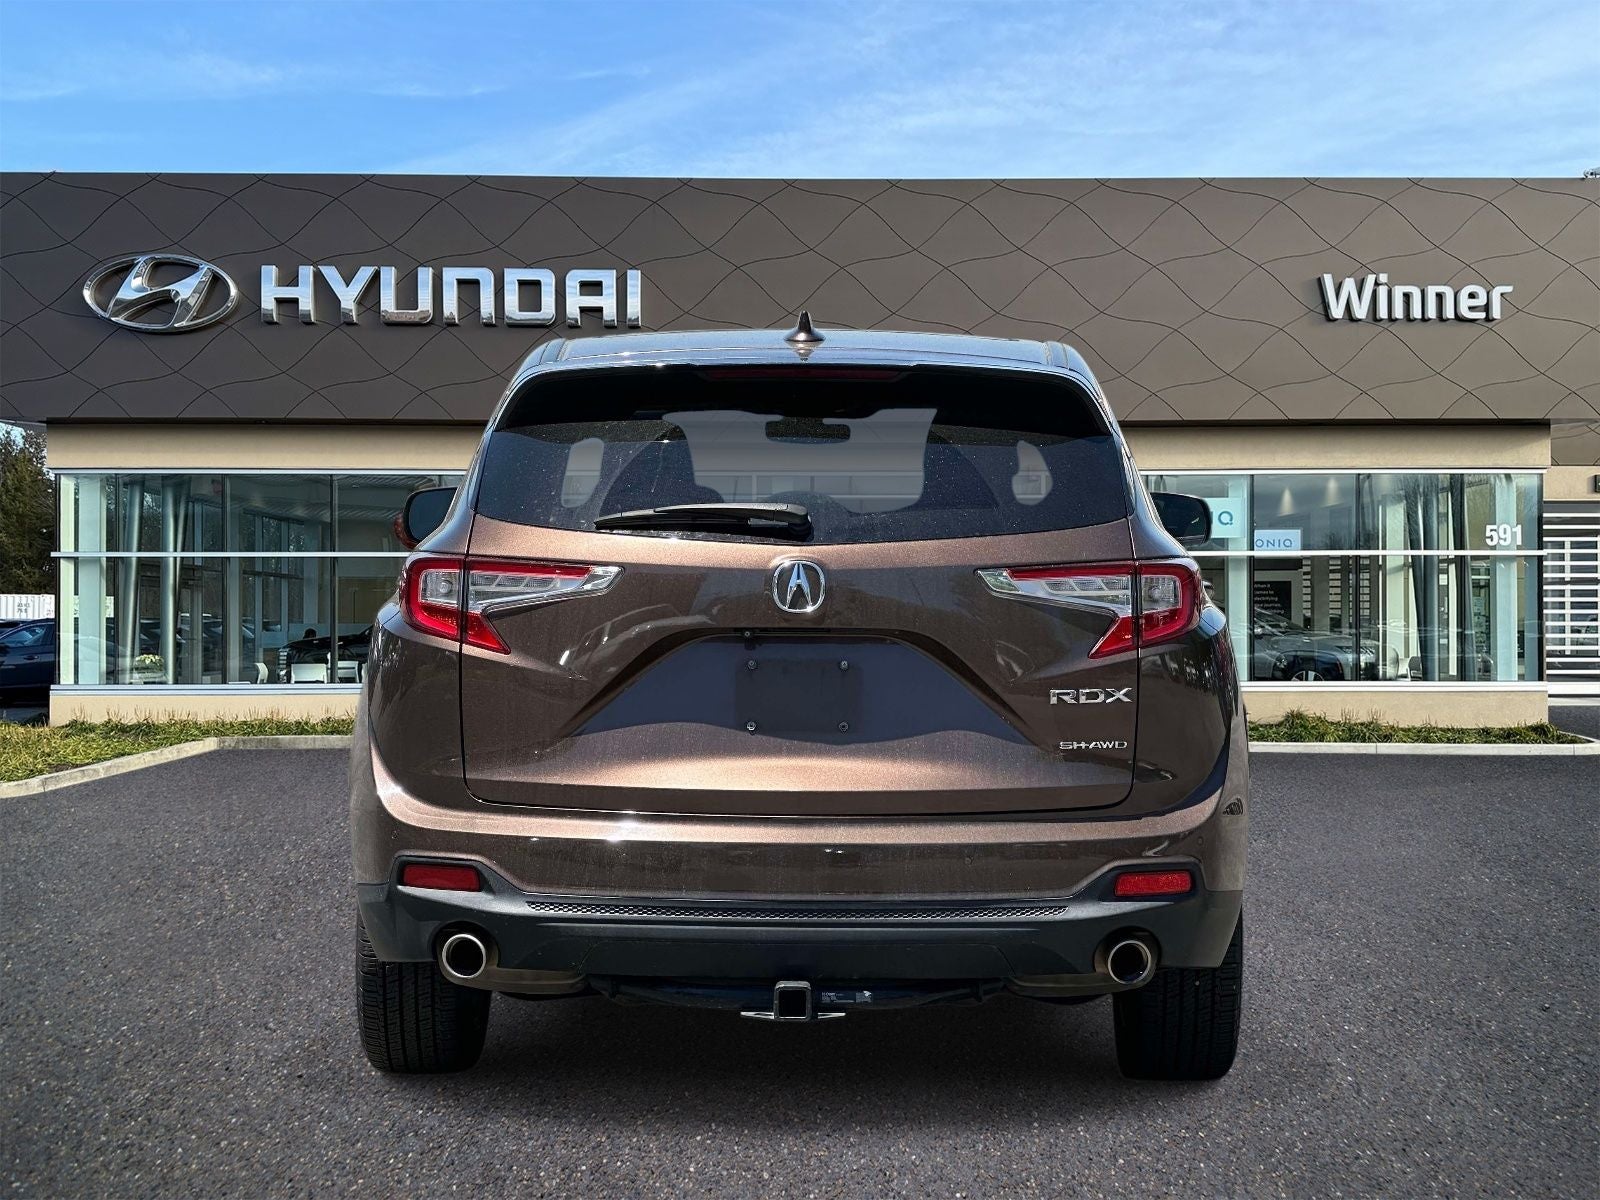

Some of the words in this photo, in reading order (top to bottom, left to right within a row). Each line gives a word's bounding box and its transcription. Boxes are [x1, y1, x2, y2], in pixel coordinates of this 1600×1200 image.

[260, 264, 642, 328] HYUNDAI
[1320, 273, 1514, 321] Winner
[1255, 538, 1293, 548] ONIQ
[1485, 524, 1522, 546] 591
[1049, 687, 1133, 705] RDX
